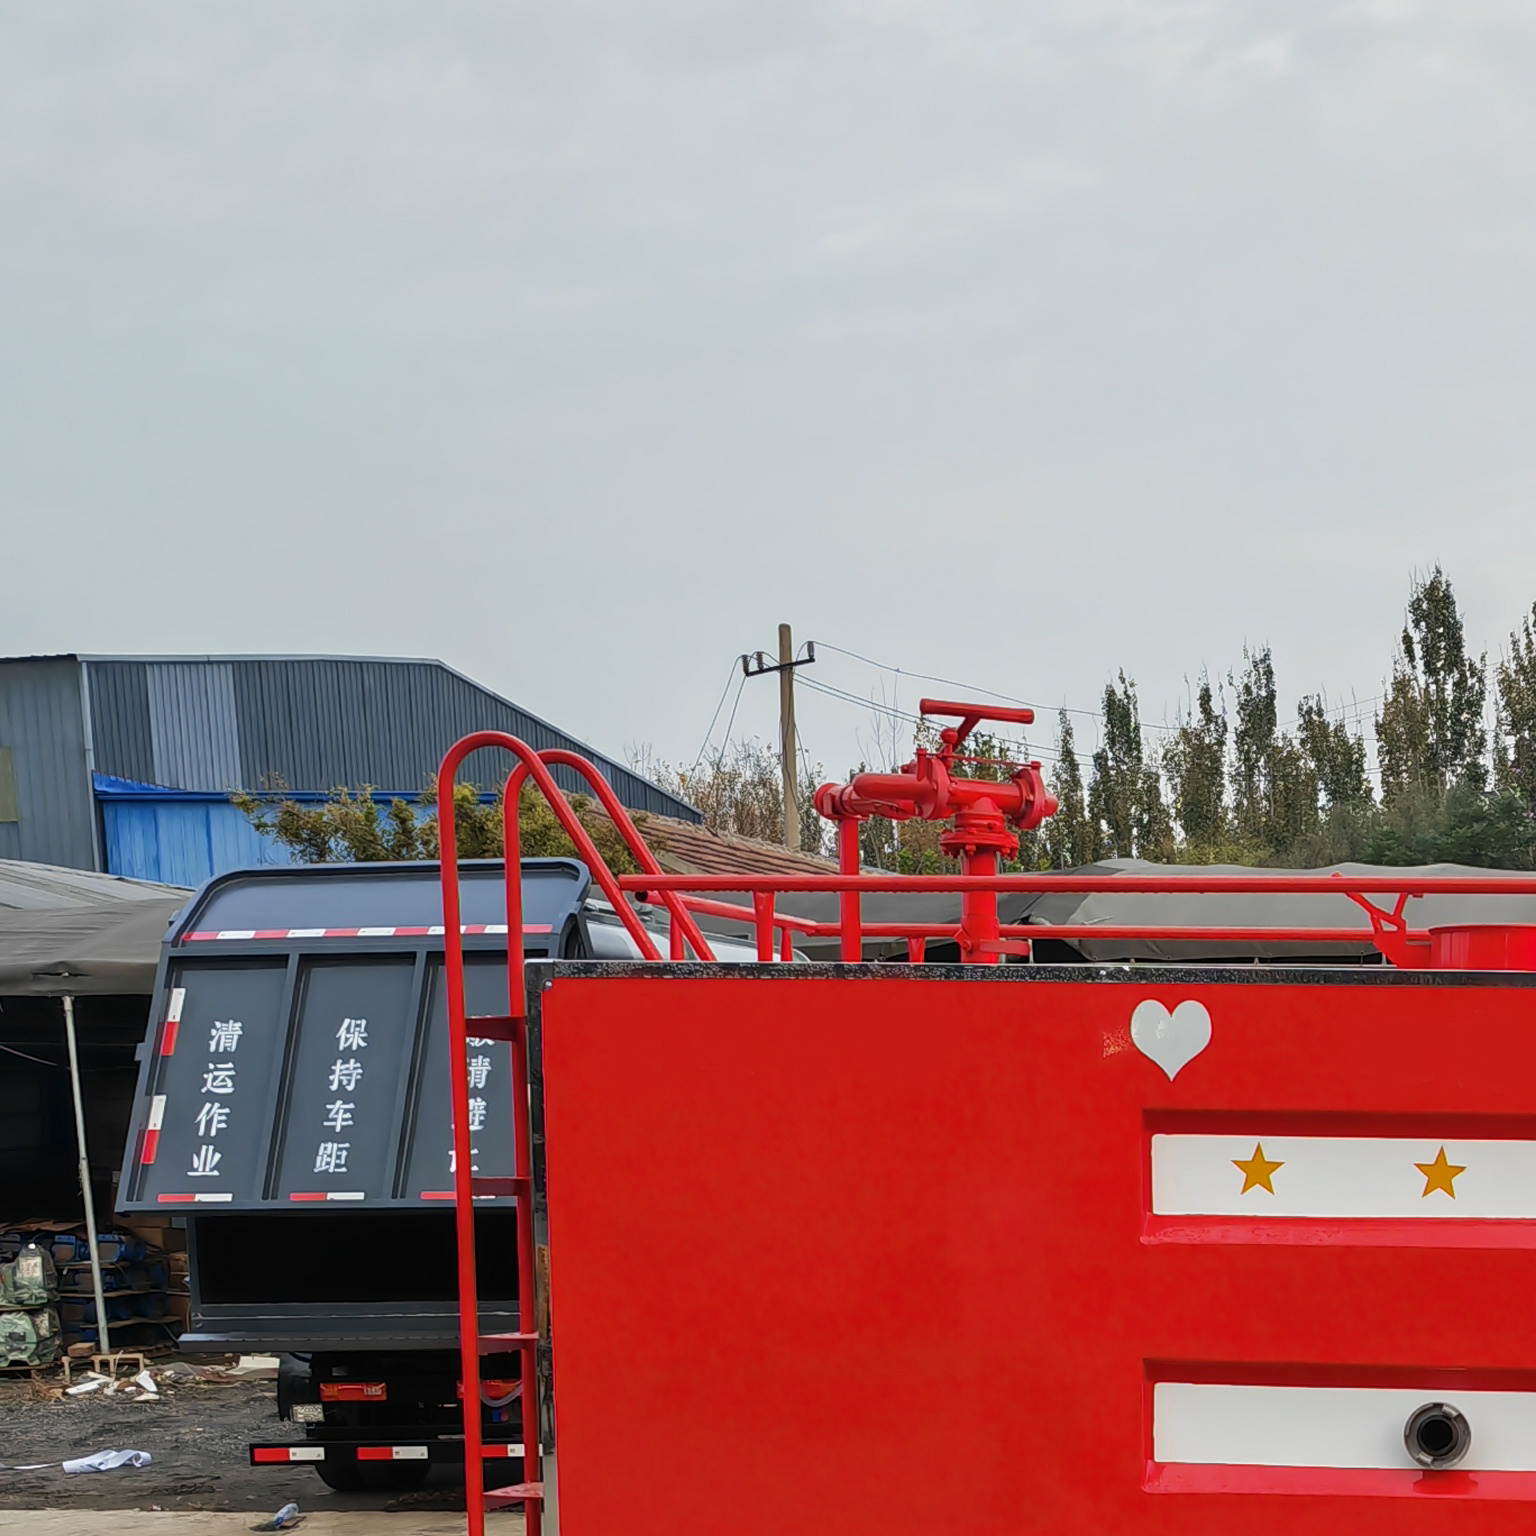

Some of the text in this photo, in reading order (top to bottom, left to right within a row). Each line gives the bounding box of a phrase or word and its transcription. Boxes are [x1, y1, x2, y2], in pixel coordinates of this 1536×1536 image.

[186, 1019, 244, 1177] 清运作业
[312, 1017, 369, 1173] 保持车距
